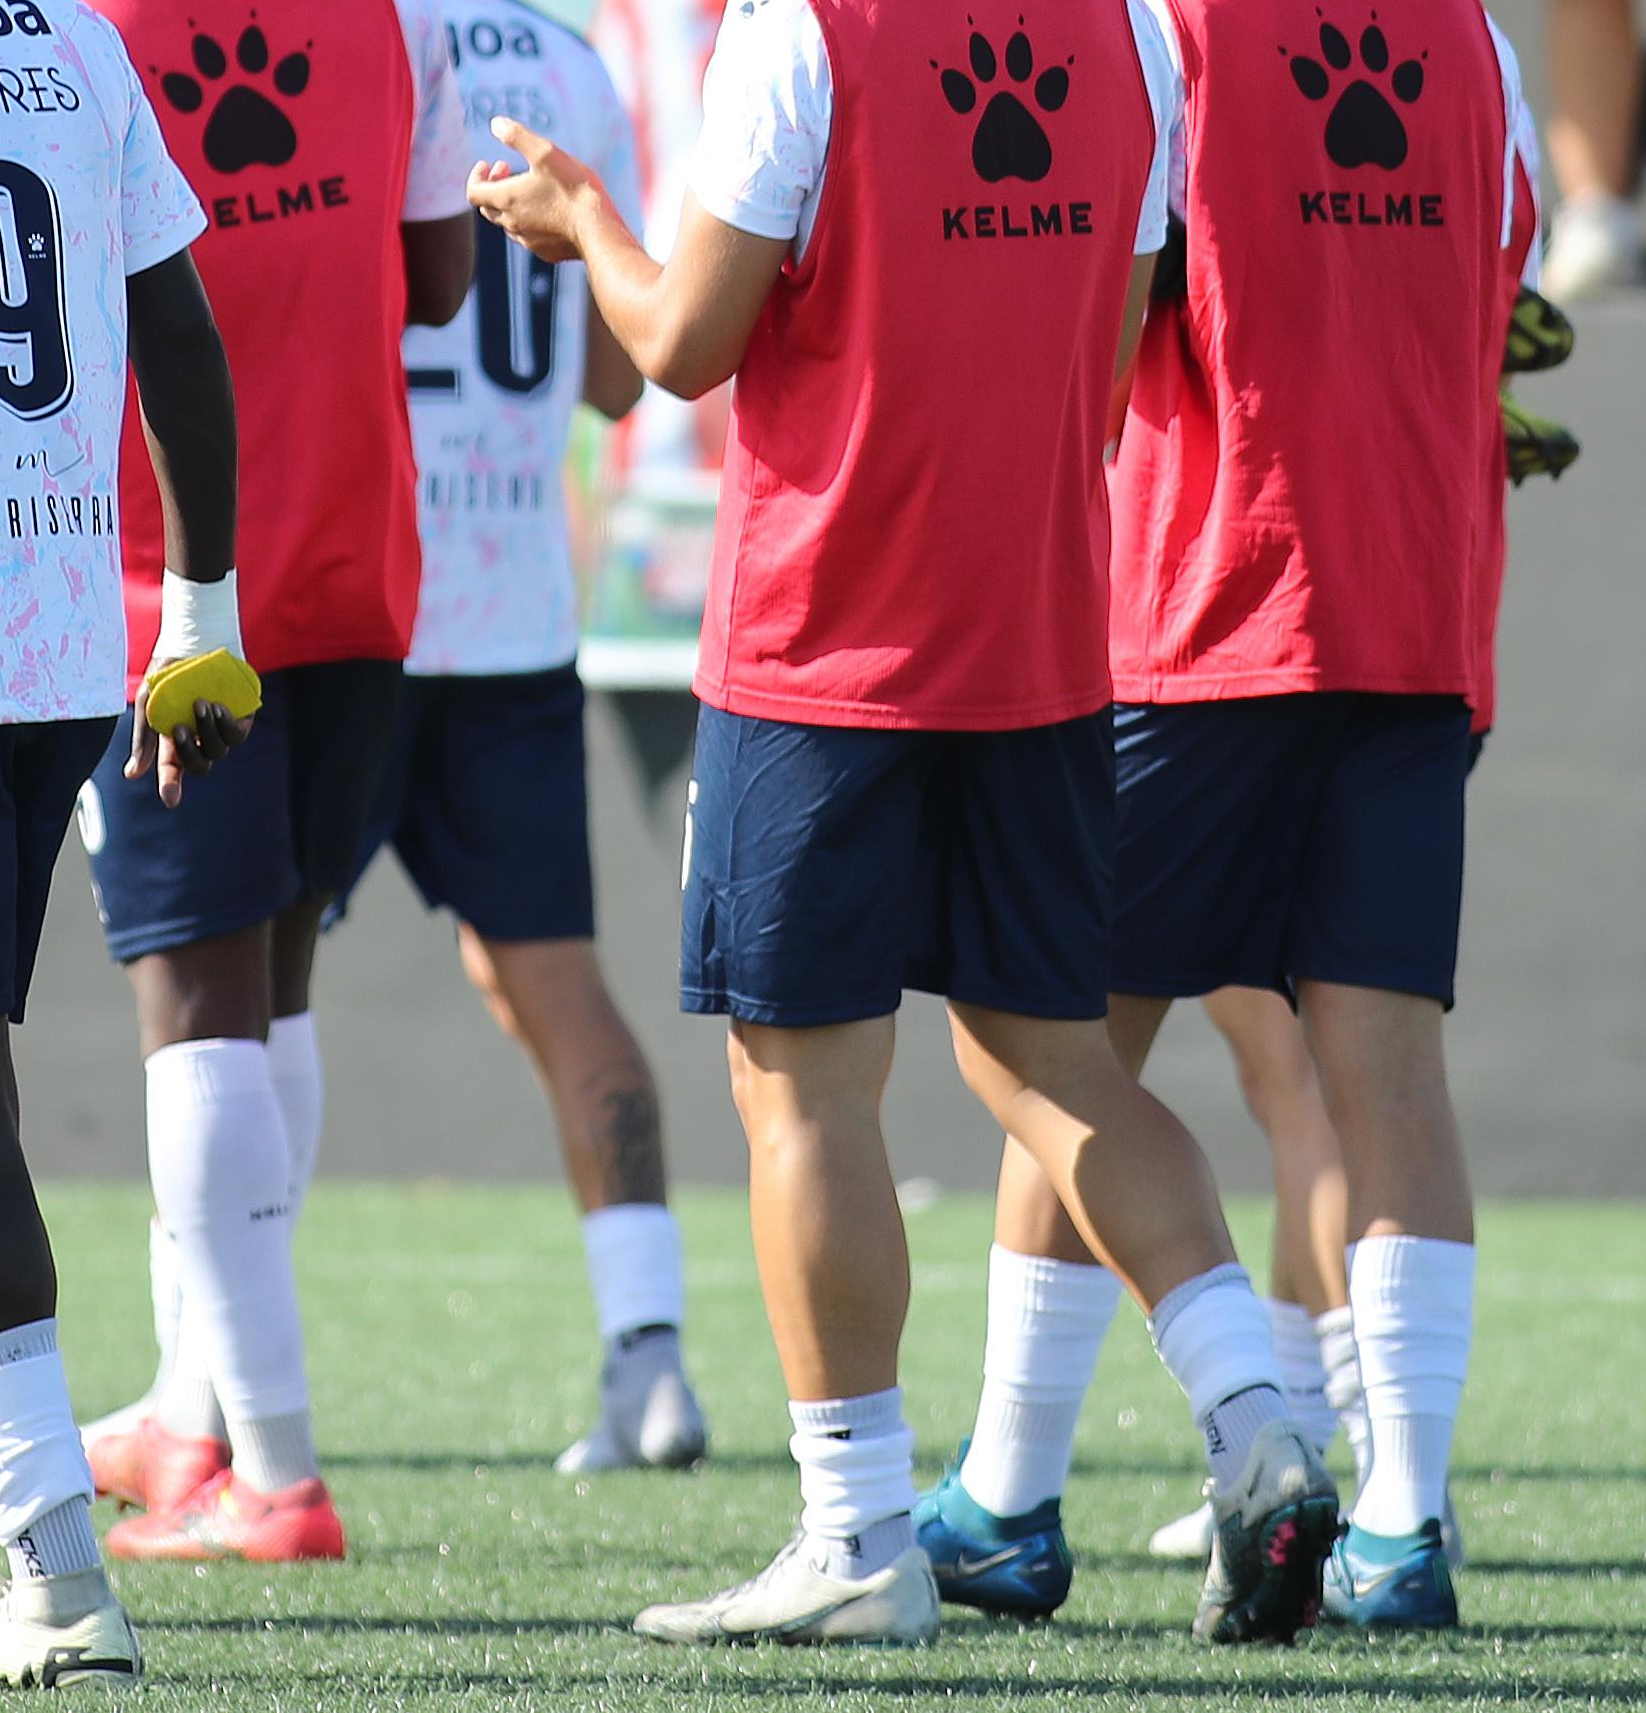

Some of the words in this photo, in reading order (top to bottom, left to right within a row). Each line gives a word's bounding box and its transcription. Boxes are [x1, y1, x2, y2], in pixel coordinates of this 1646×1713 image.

[212, 176, 351, 231] ELME
[942, 201, 1094, 241] KELME
[1299, 191, 1445, 227] KELME
